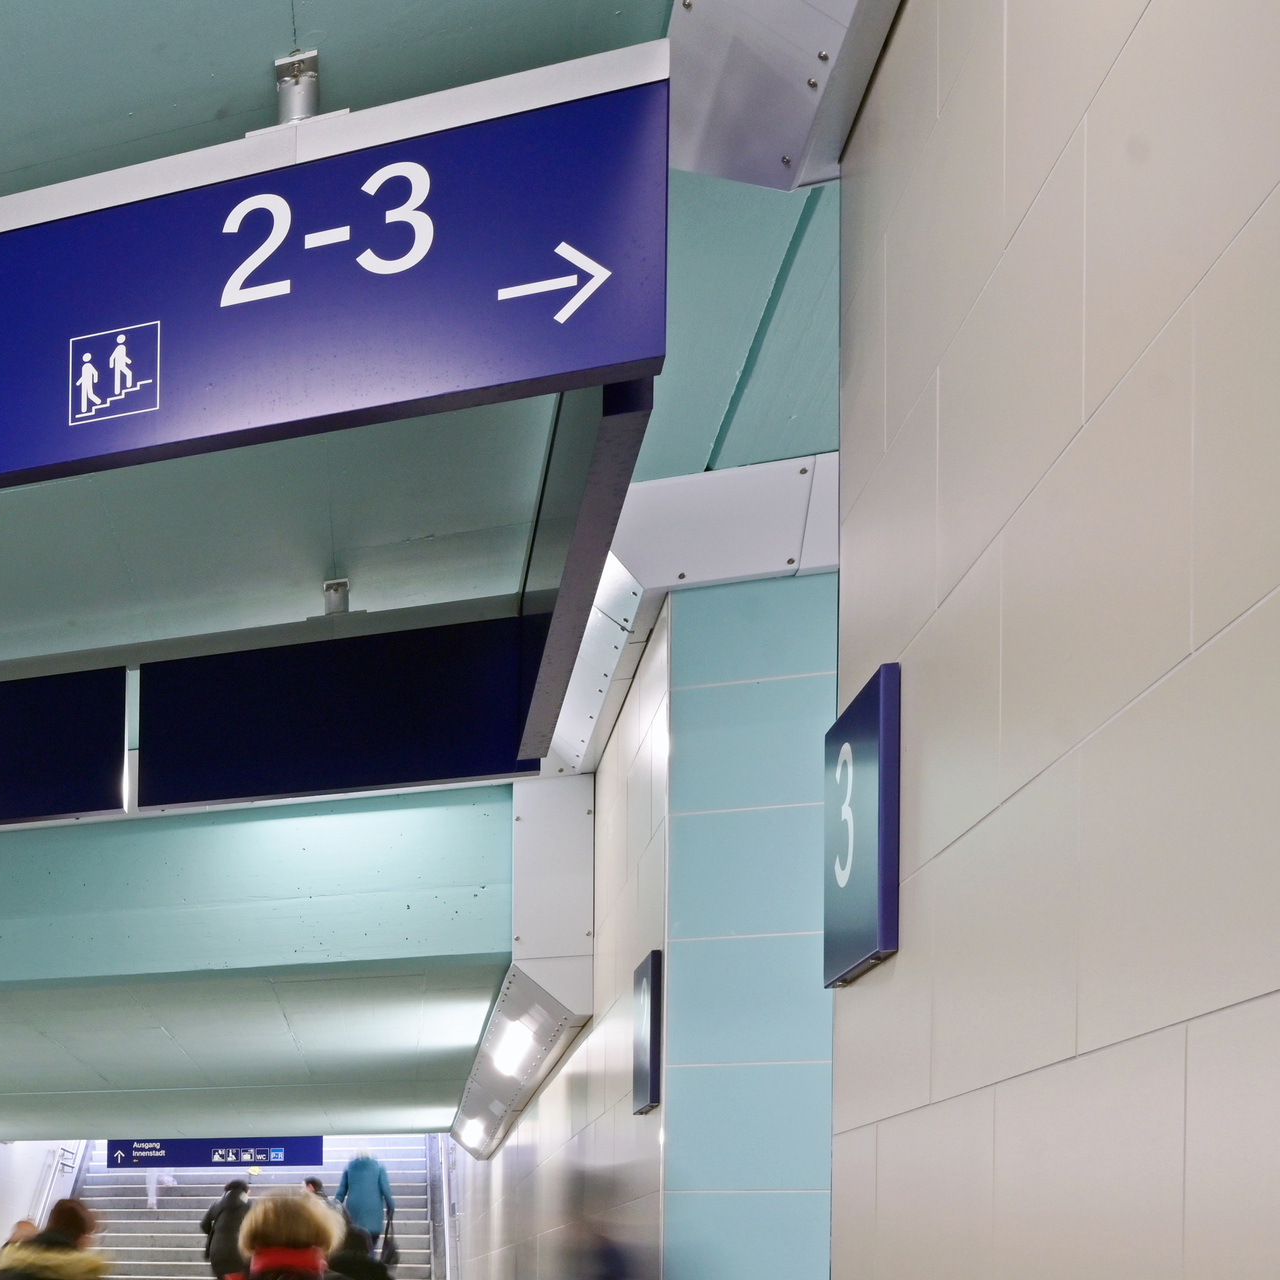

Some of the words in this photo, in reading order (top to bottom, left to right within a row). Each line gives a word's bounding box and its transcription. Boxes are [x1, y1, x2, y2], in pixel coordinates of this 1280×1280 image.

[220, 161, 434, 307] 2-3
[834, 742, 854, 888] 3
[132, 1141, 161, 1150] Ausgang
[132, 1149, 166, 1157] Innenstadt
